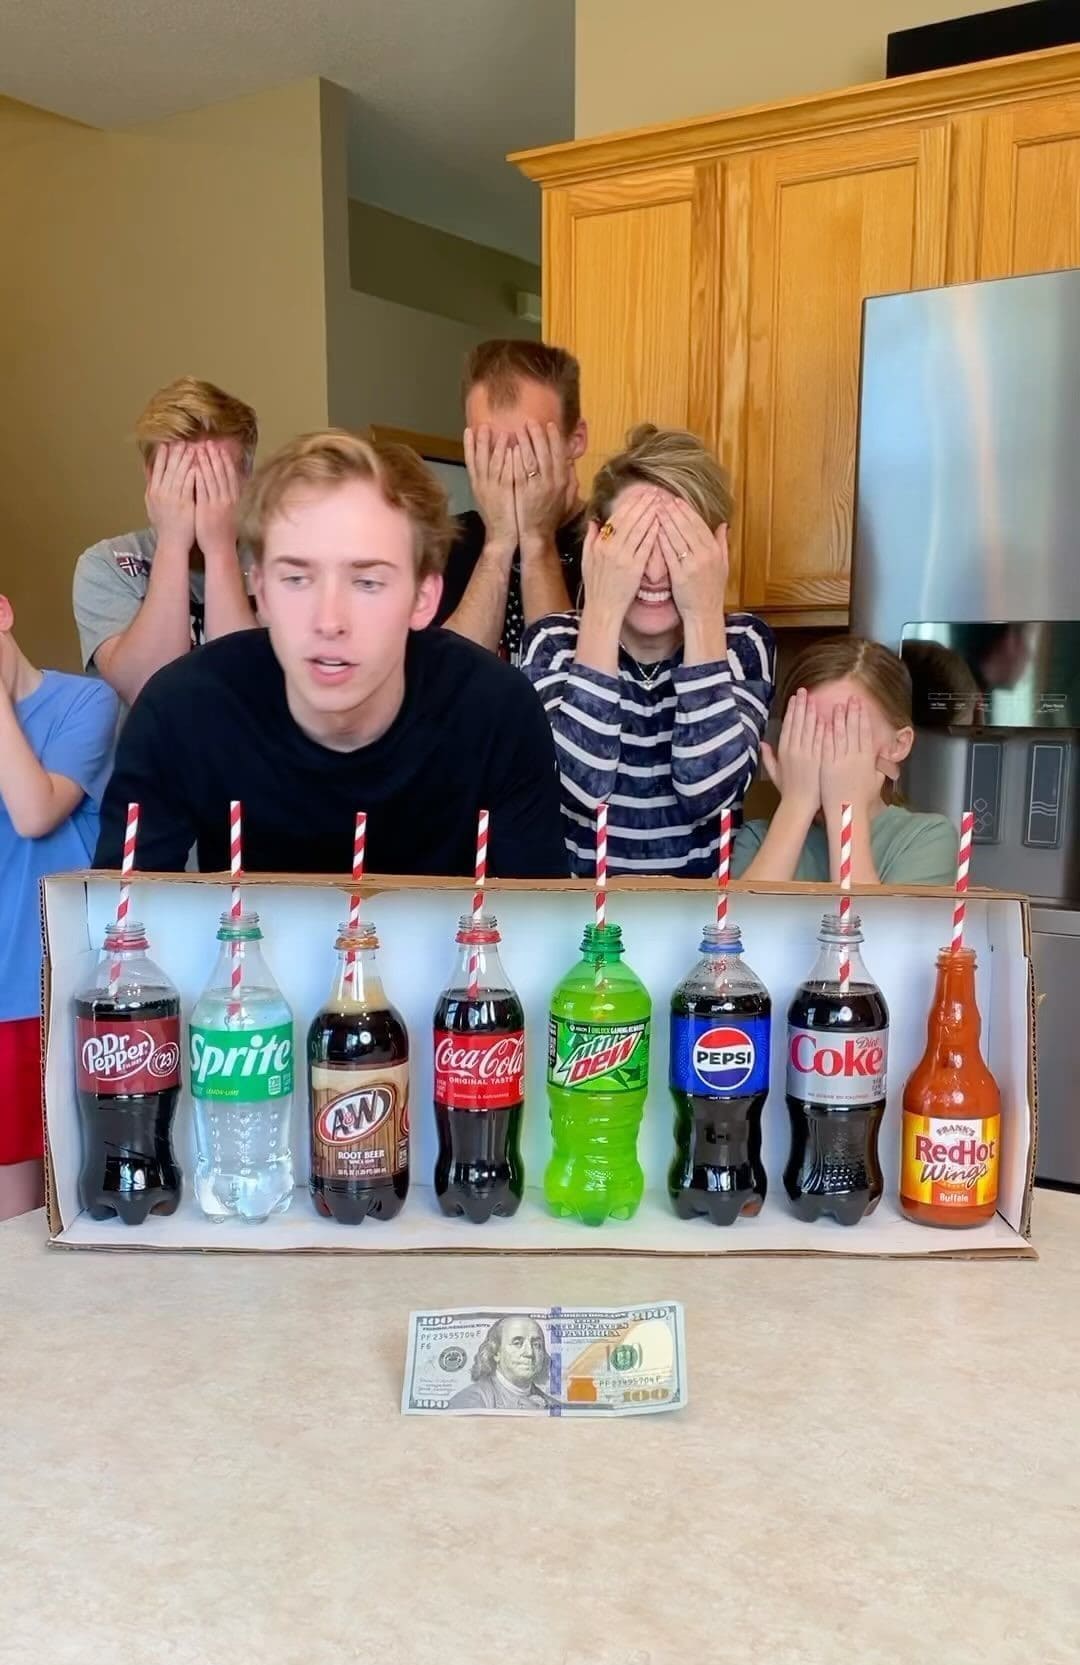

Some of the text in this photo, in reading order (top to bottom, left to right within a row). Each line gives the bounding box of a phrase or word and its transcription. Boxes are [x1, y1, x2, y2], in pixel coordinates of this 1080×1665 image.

[101, 1033, 131, 1056] Dr
[87, 1037, 150, 1075] Pepper
[159, 1051, 173, 1069] 23
[191, 1033, 290, 1083] Sprite
[435, 1034, 524, 1079] Coca-Cola
[564, 1032, 642, 1087] DEW
[697, 1051, 752, 1065] PEPSI
[791, 1033, 884, 1077] Coke
[448, 1076, 514, 1086] ORIGINAL TASTE
[331, 1088, 380, 1141] A&W
[936, 1124, 976, 1137] FRANK'S
[338, 1149, 385, 1160] ROOT BEER
[915, 1134, 995, 1165] RedHot
[920, 1163, 988, 1188] Wings
[940, 1192, 969, 1203] Buffalo
[420, 1316, 454, 1326] 100
[631, 1309, 667, 1322] 100
[415, 1399, 449, 1409] 100
